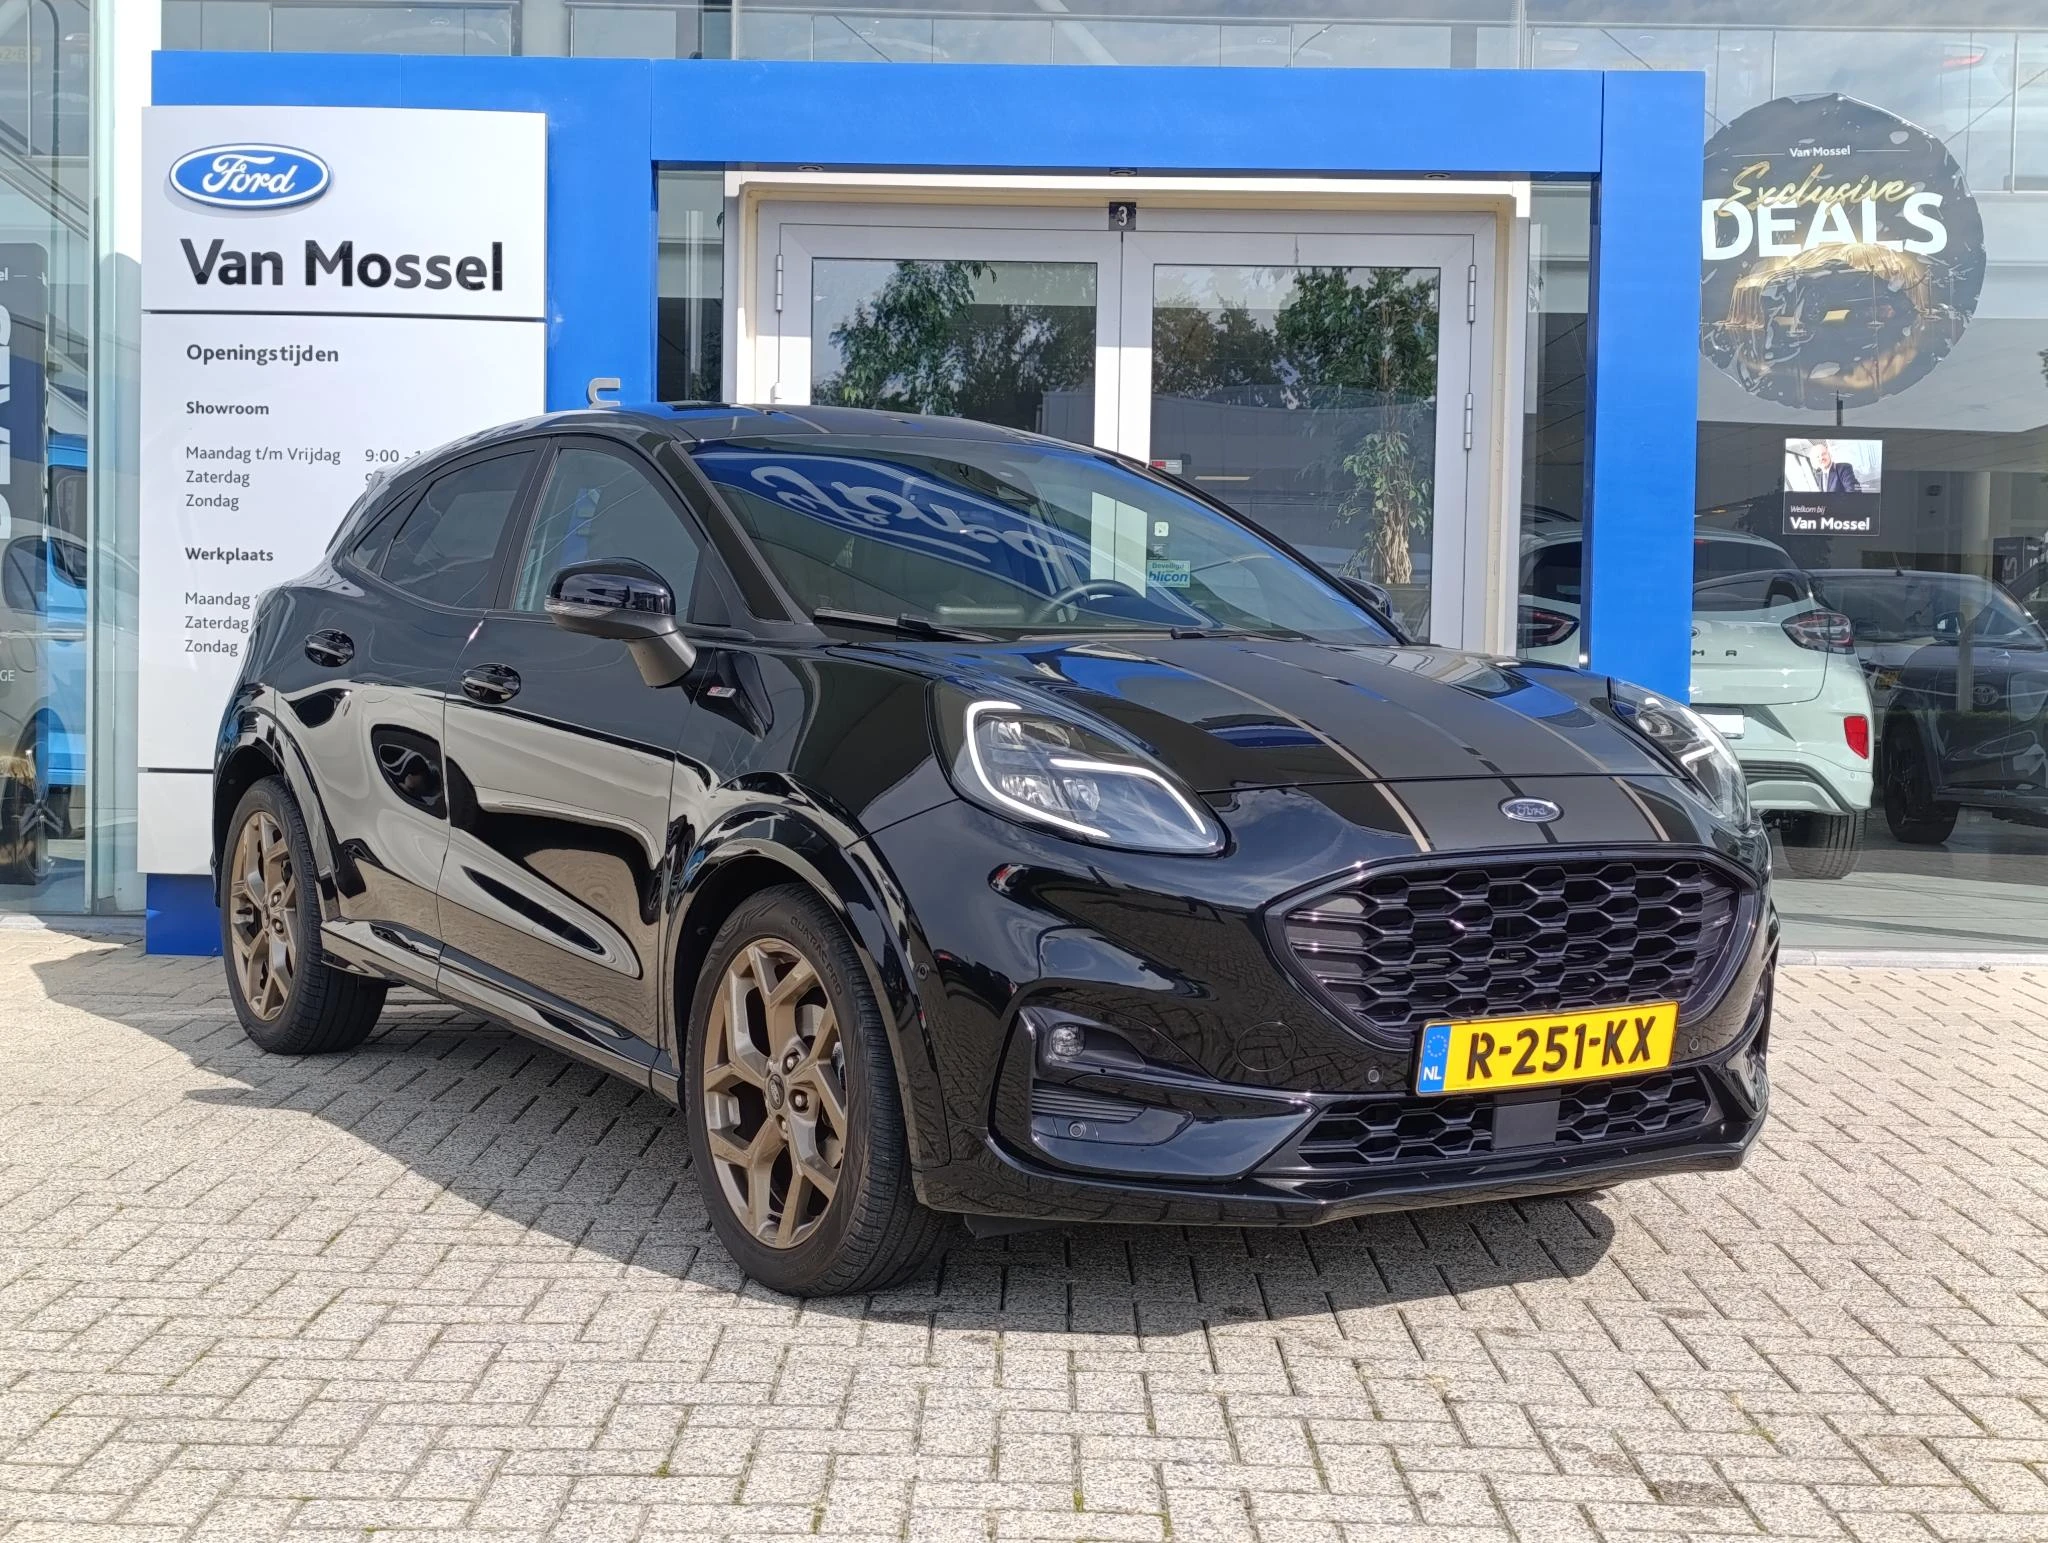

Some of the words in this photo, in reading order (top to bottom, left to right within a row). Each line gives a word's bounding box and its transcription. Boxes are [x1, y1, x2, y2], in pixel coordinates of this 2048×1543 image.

[1789, 147, 1810, 157] Van
[1813, 145, 1850, 156] Mossel
[202, 154, 298, 193] Ford
[1717, 160, 1916, 217] Exclusive
[1118, 206, 1128, 227] 3
[1702, 192, 1948, 260] DEALS
[180, 239, 283, 285] Van
[306, 240, 502, 291] Mossel
[187, 344, 338, 366] Openingstijden
[187, 401, 269, 414] Showroom
[186, 446, 251, 463] Maandag
[256, 447, 282, 460] t/m
[288, 447, 341, 465] Vrijdag
[365, 449, 399, 463] 9:00
[186, 470, 250, 487] Zaterdag
[186, 494, 239, 511] Zondag
[1790, 516, 1816, 530] Van
[1820, 517, 1870, 530] Mossel
[185, 547, 273, 564] Werkplaats
[185, 592, 250, 609] Maandag
[185, 616, 249, 633] Zaterdag
[185, 640, 238, 657] Zondag
[1423, 1066, 1442, 1081] NL
[1466, 1015, 1657, 1081] R-251-KX
